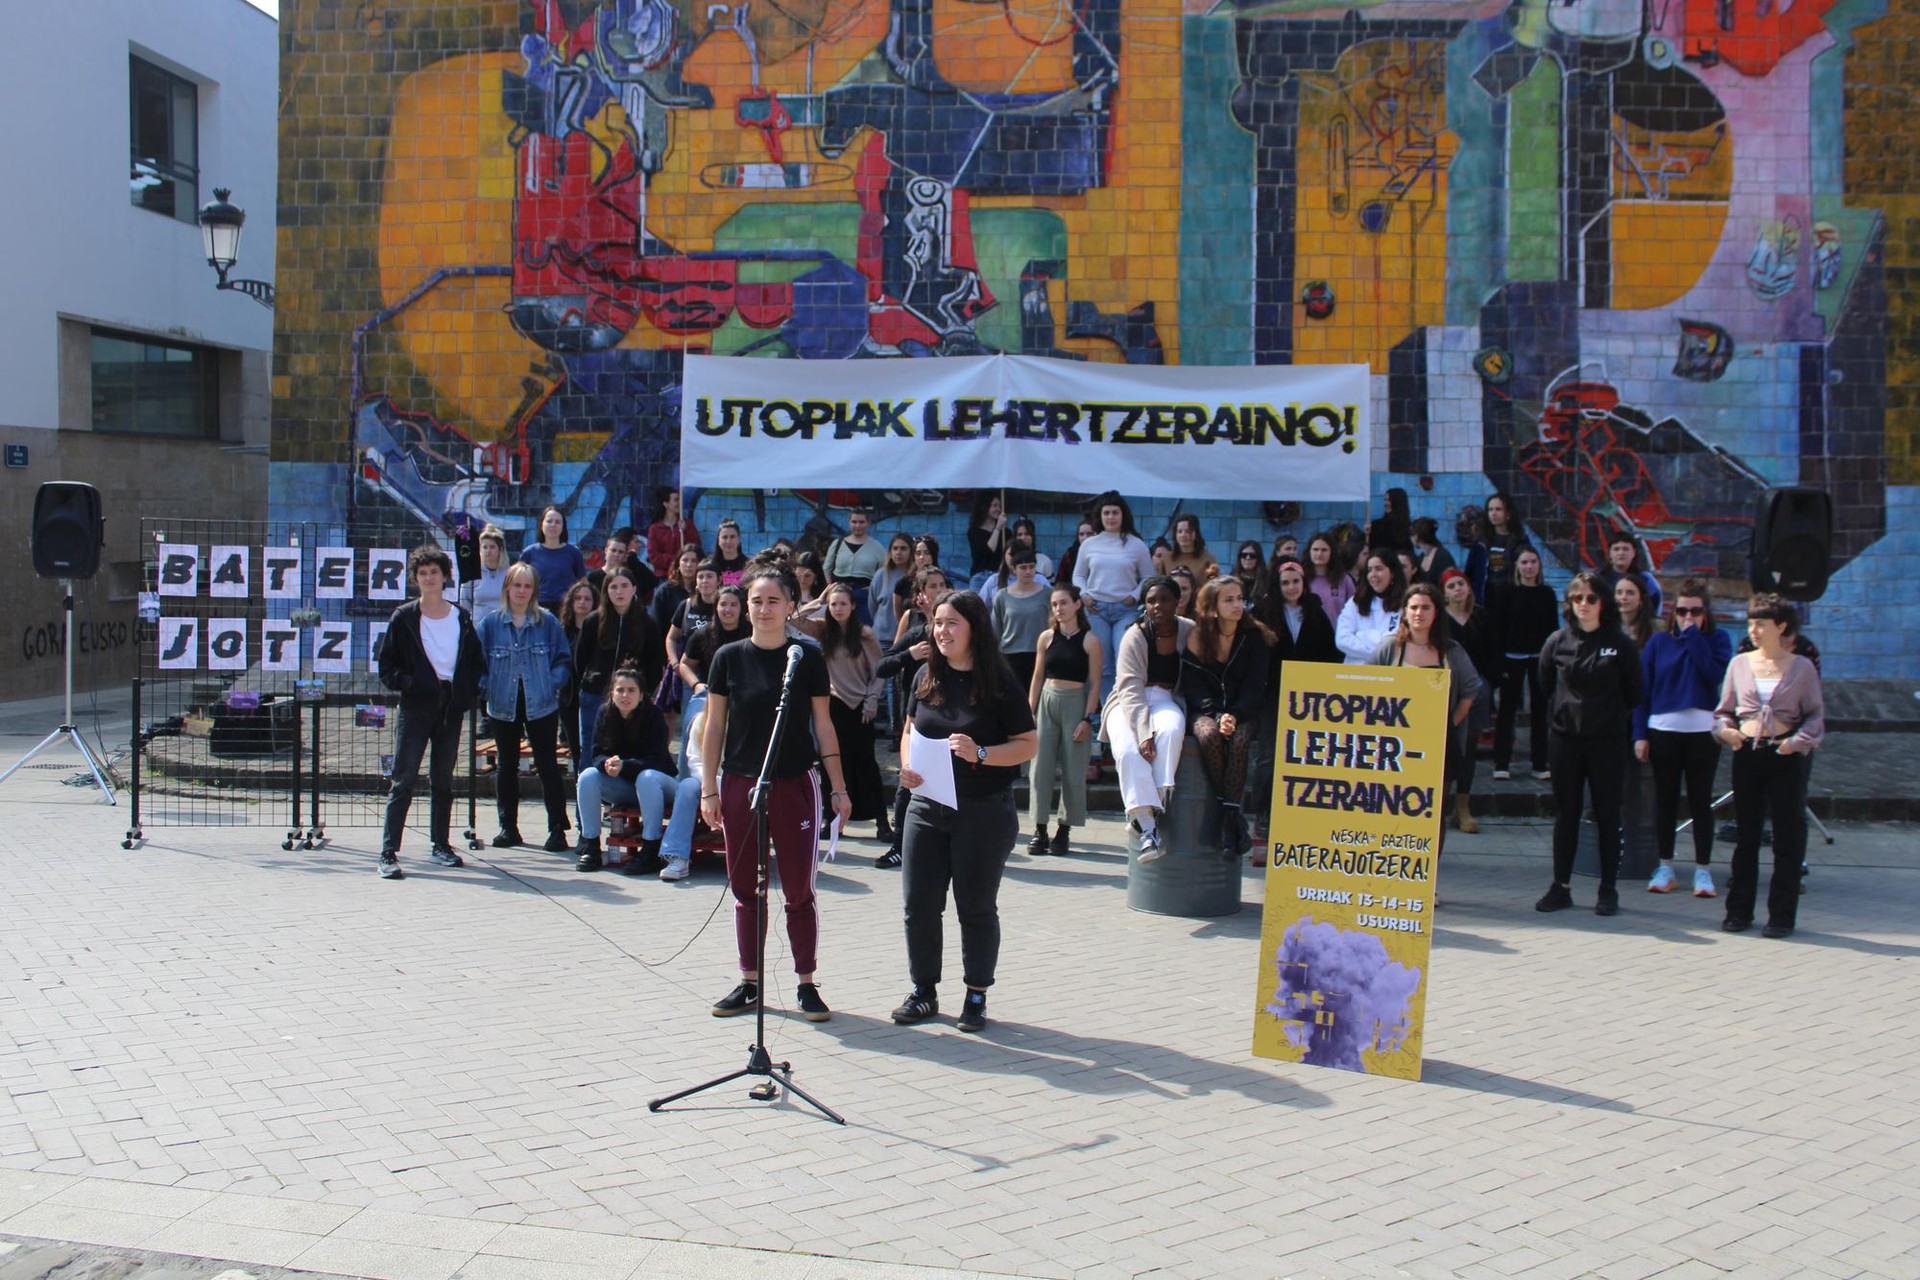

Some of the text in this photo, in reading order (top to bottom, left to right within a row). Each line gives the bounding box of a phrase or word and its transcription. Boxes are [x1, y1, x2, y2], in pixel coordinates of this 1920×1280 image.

[695, 396, 1358, 454] UTOPIAK LEHERTZERAINO!
[162, 553, 455, 590] BATER
[79, 621, 127, 652] EUSKO
[1288, 691, 1411, 728] UTOPIAK
[1284, 729, 1425, 773] LEHER-
[1282, 775, 1435, 818] TZERAINO!
[1381, 834, 1431, 851] GAZTEOK
[1296, 886, 1424, 913] URRIAK 13-14-15
[1356, 913, 1424, 934] USURBIL
